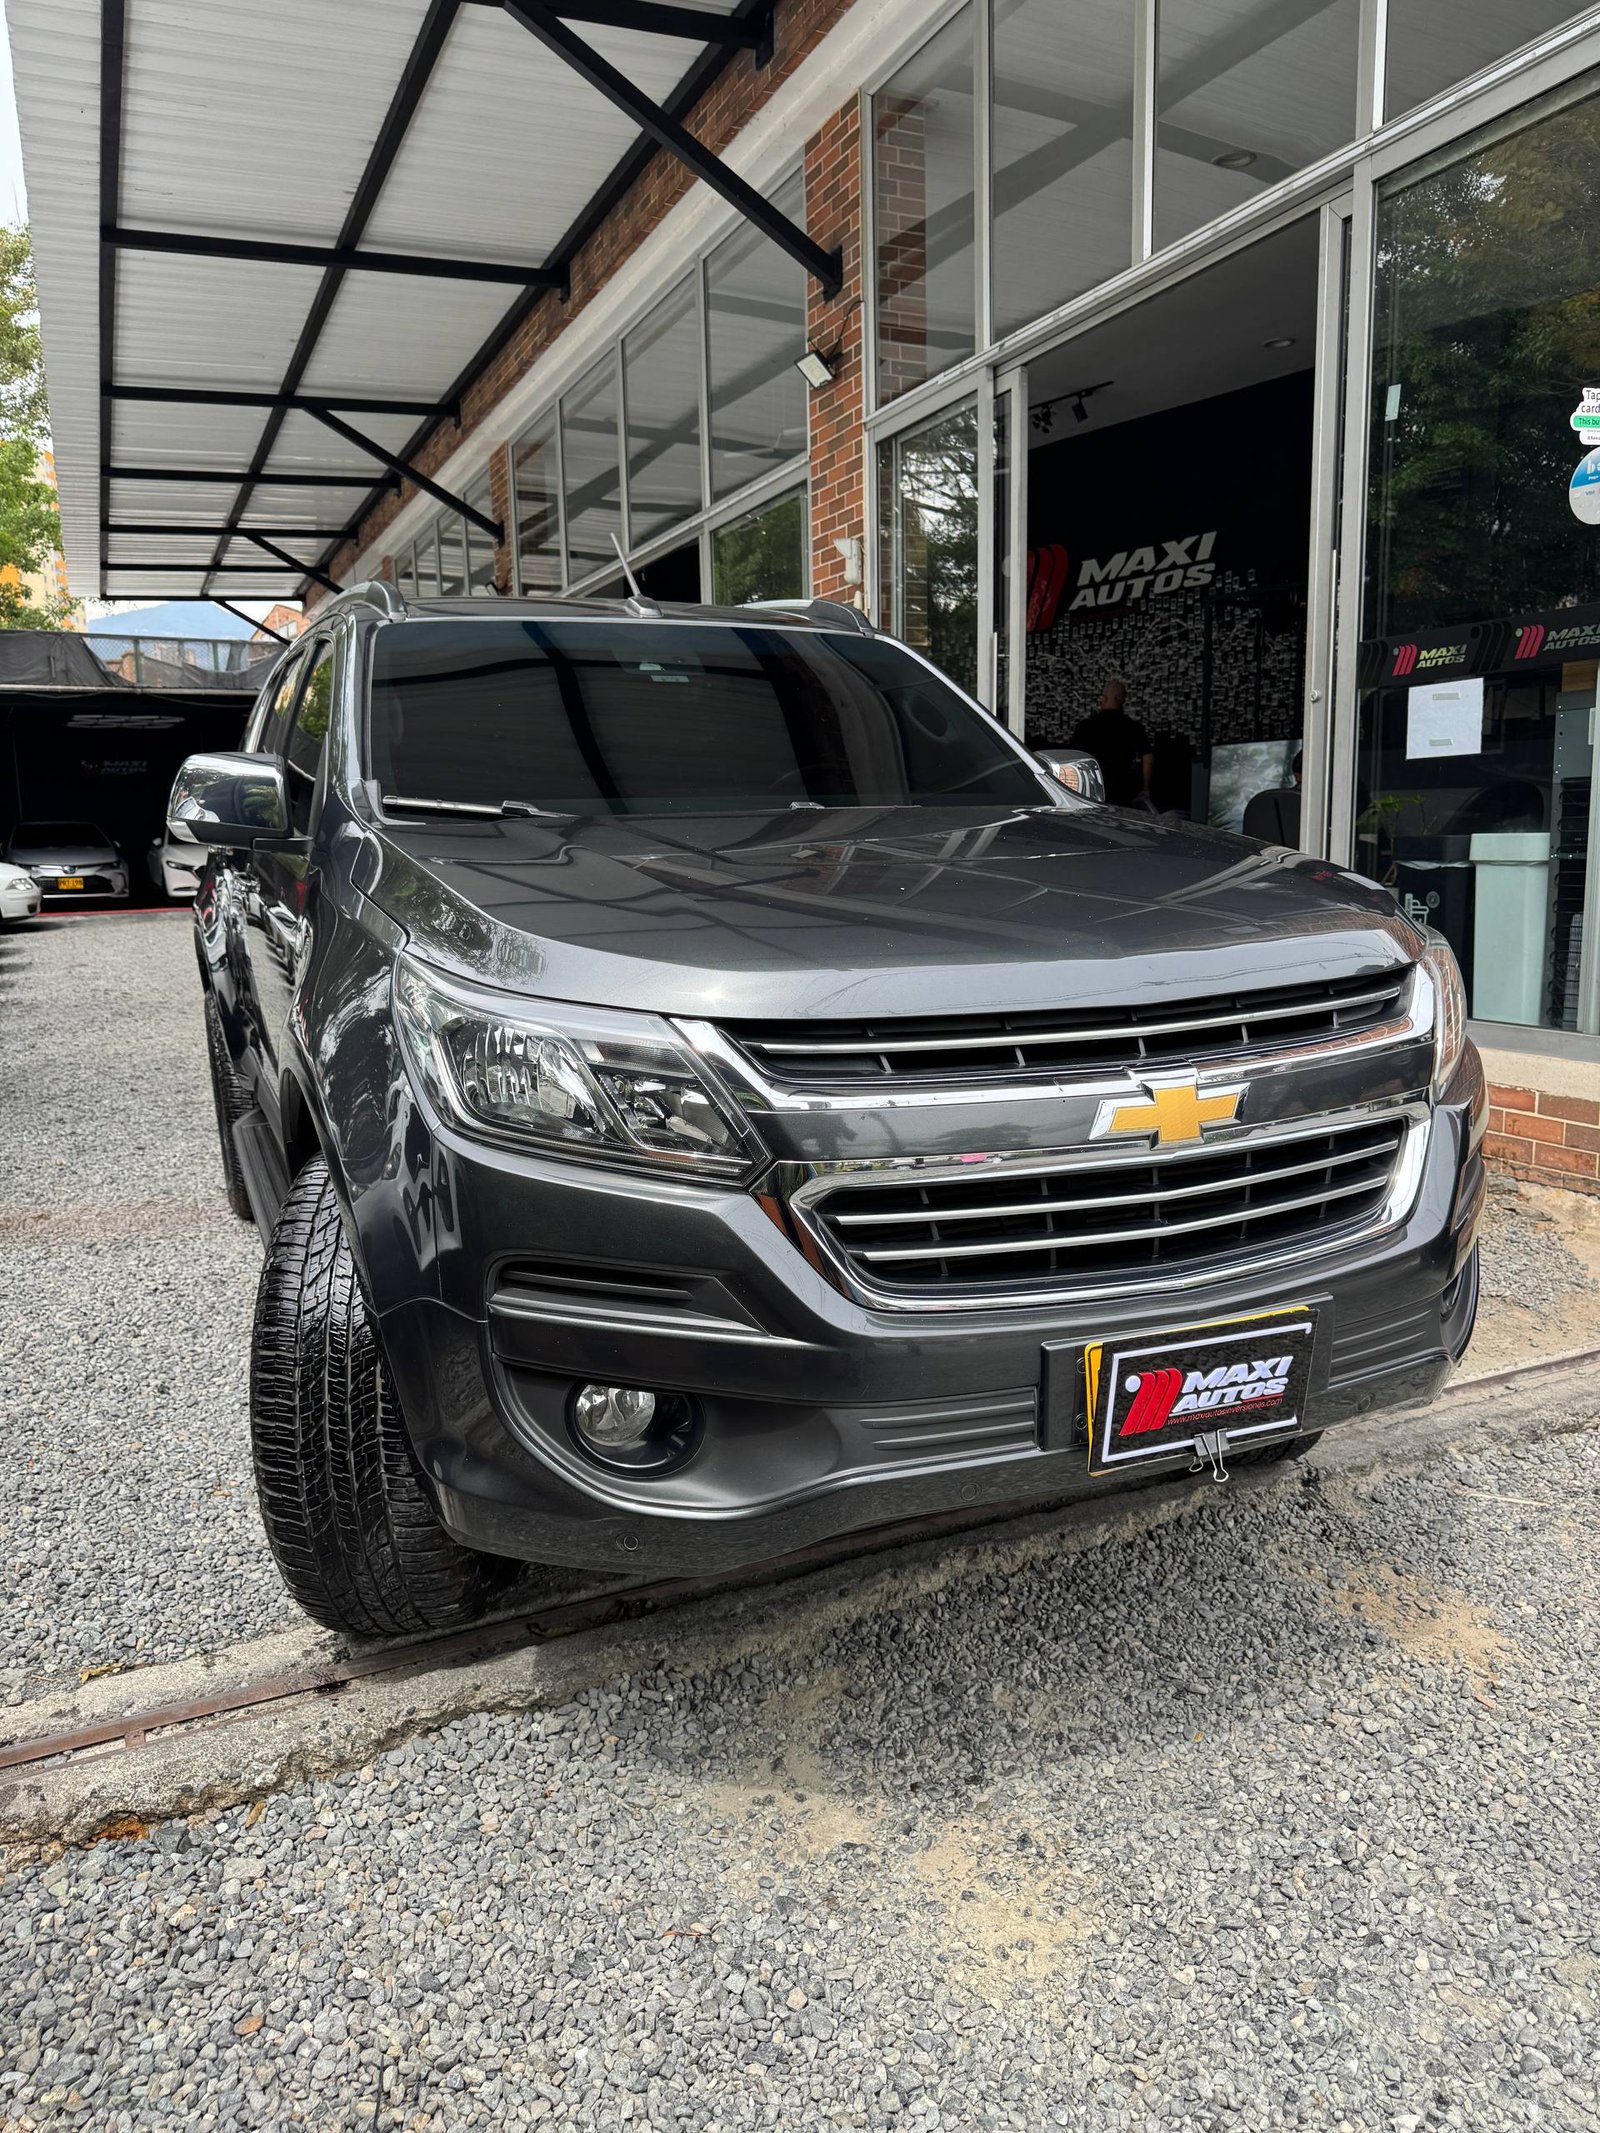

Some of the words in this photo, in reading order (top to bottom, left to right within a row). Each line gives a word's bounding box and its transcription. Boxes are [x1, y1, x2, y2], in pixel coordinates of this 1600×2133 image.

[1077, 531, 1217, 586] MAXI
[1068, 563, 1216, 610] AUTOS
[1419, 644, 1467, 659] MAXI
[1543, 635, 1600, 651] AUTOS
[1416, 655, 1466, 669] AUTOS
[1181, 1356, 1294, 1393] MAXI
[1172, 1378, 1289, 1413] AUTOS
[1167, 1398, 1283, 1426] www.maxiautosinversiones.com
